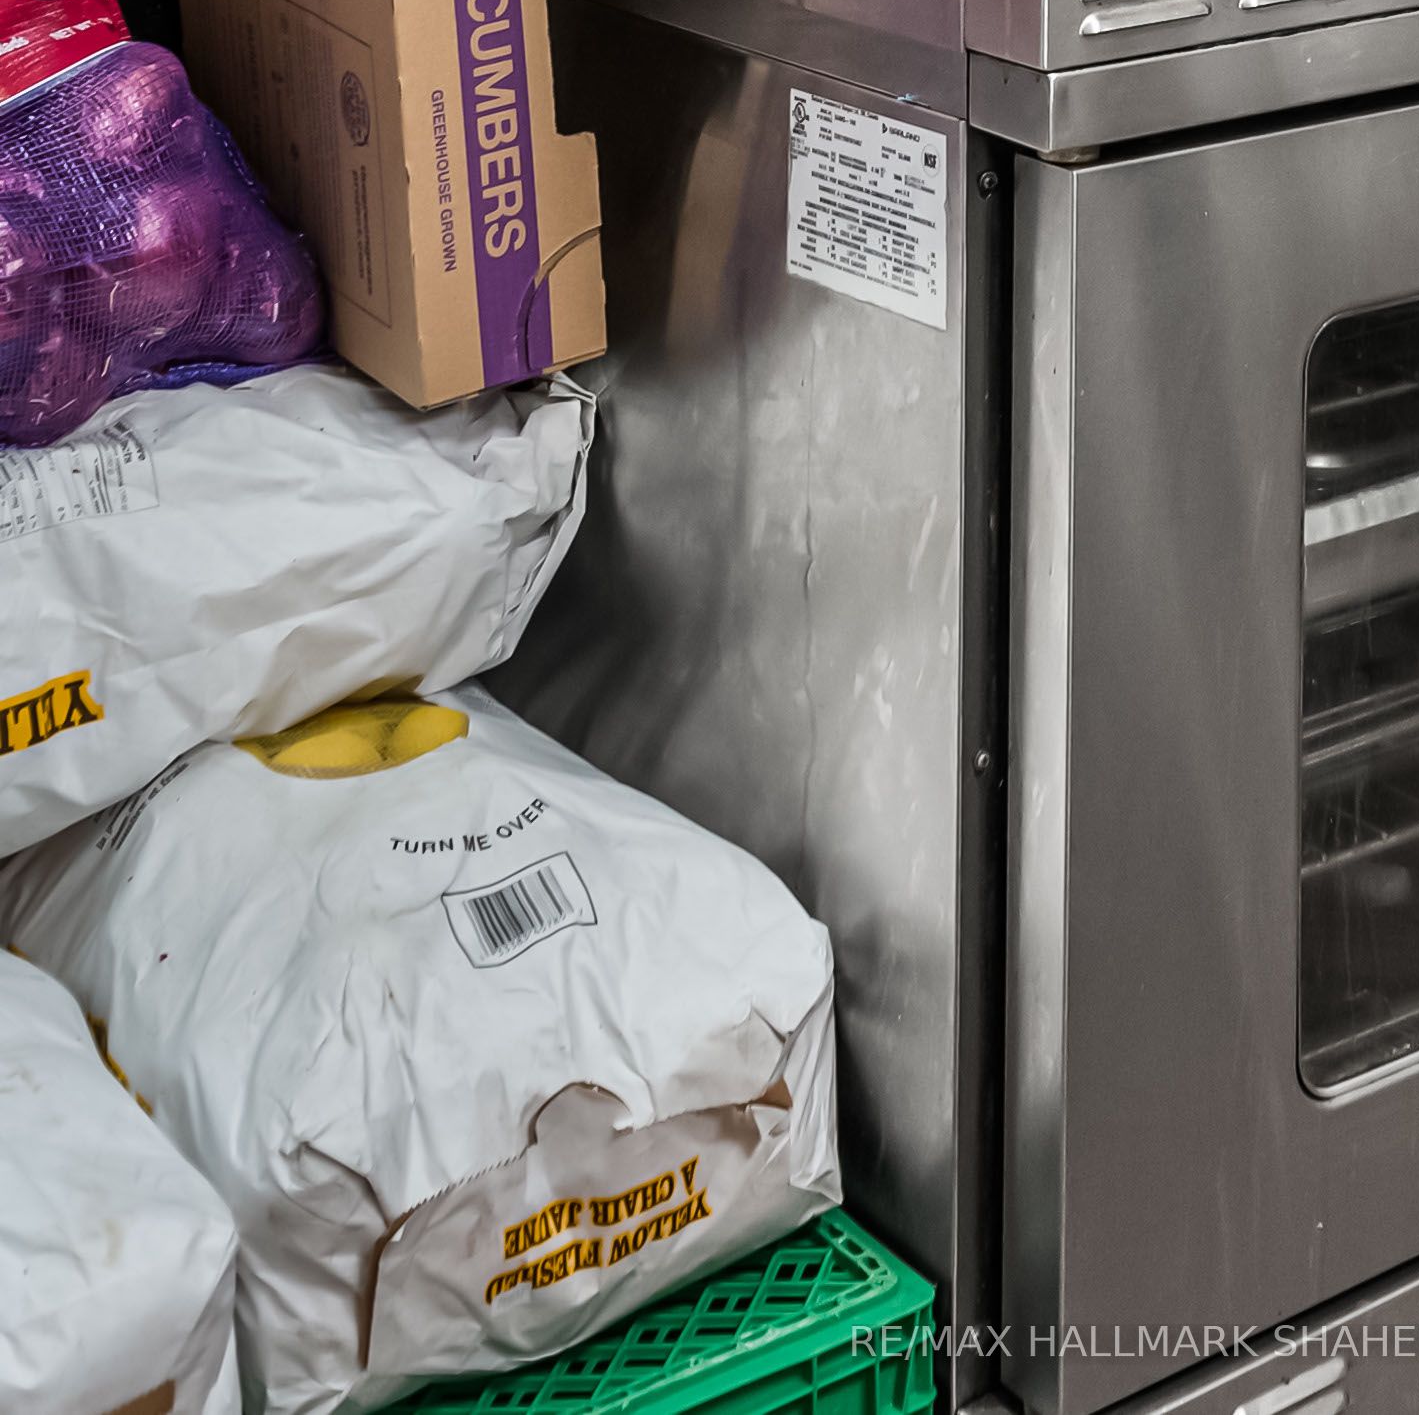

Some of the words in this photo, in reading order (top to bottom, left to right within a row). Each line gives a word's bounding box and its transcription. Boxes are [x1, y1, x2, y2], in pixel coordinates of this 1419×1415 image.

[430, 88, 453, 206] GREENHOUSE
[923, 151, 938, 170] NSF
[438, 207, 458, 274] GROWN
[389, 836, 455, 855] TURN
[461, 833, 493, 853] ME
[495, 797, 551, 840] OVER
[502, 1197, 587, 1261] JAUNE
[588, 1171, 676, 1227] CHAIR
[607, 1187, 713, 1268] YELLOW
